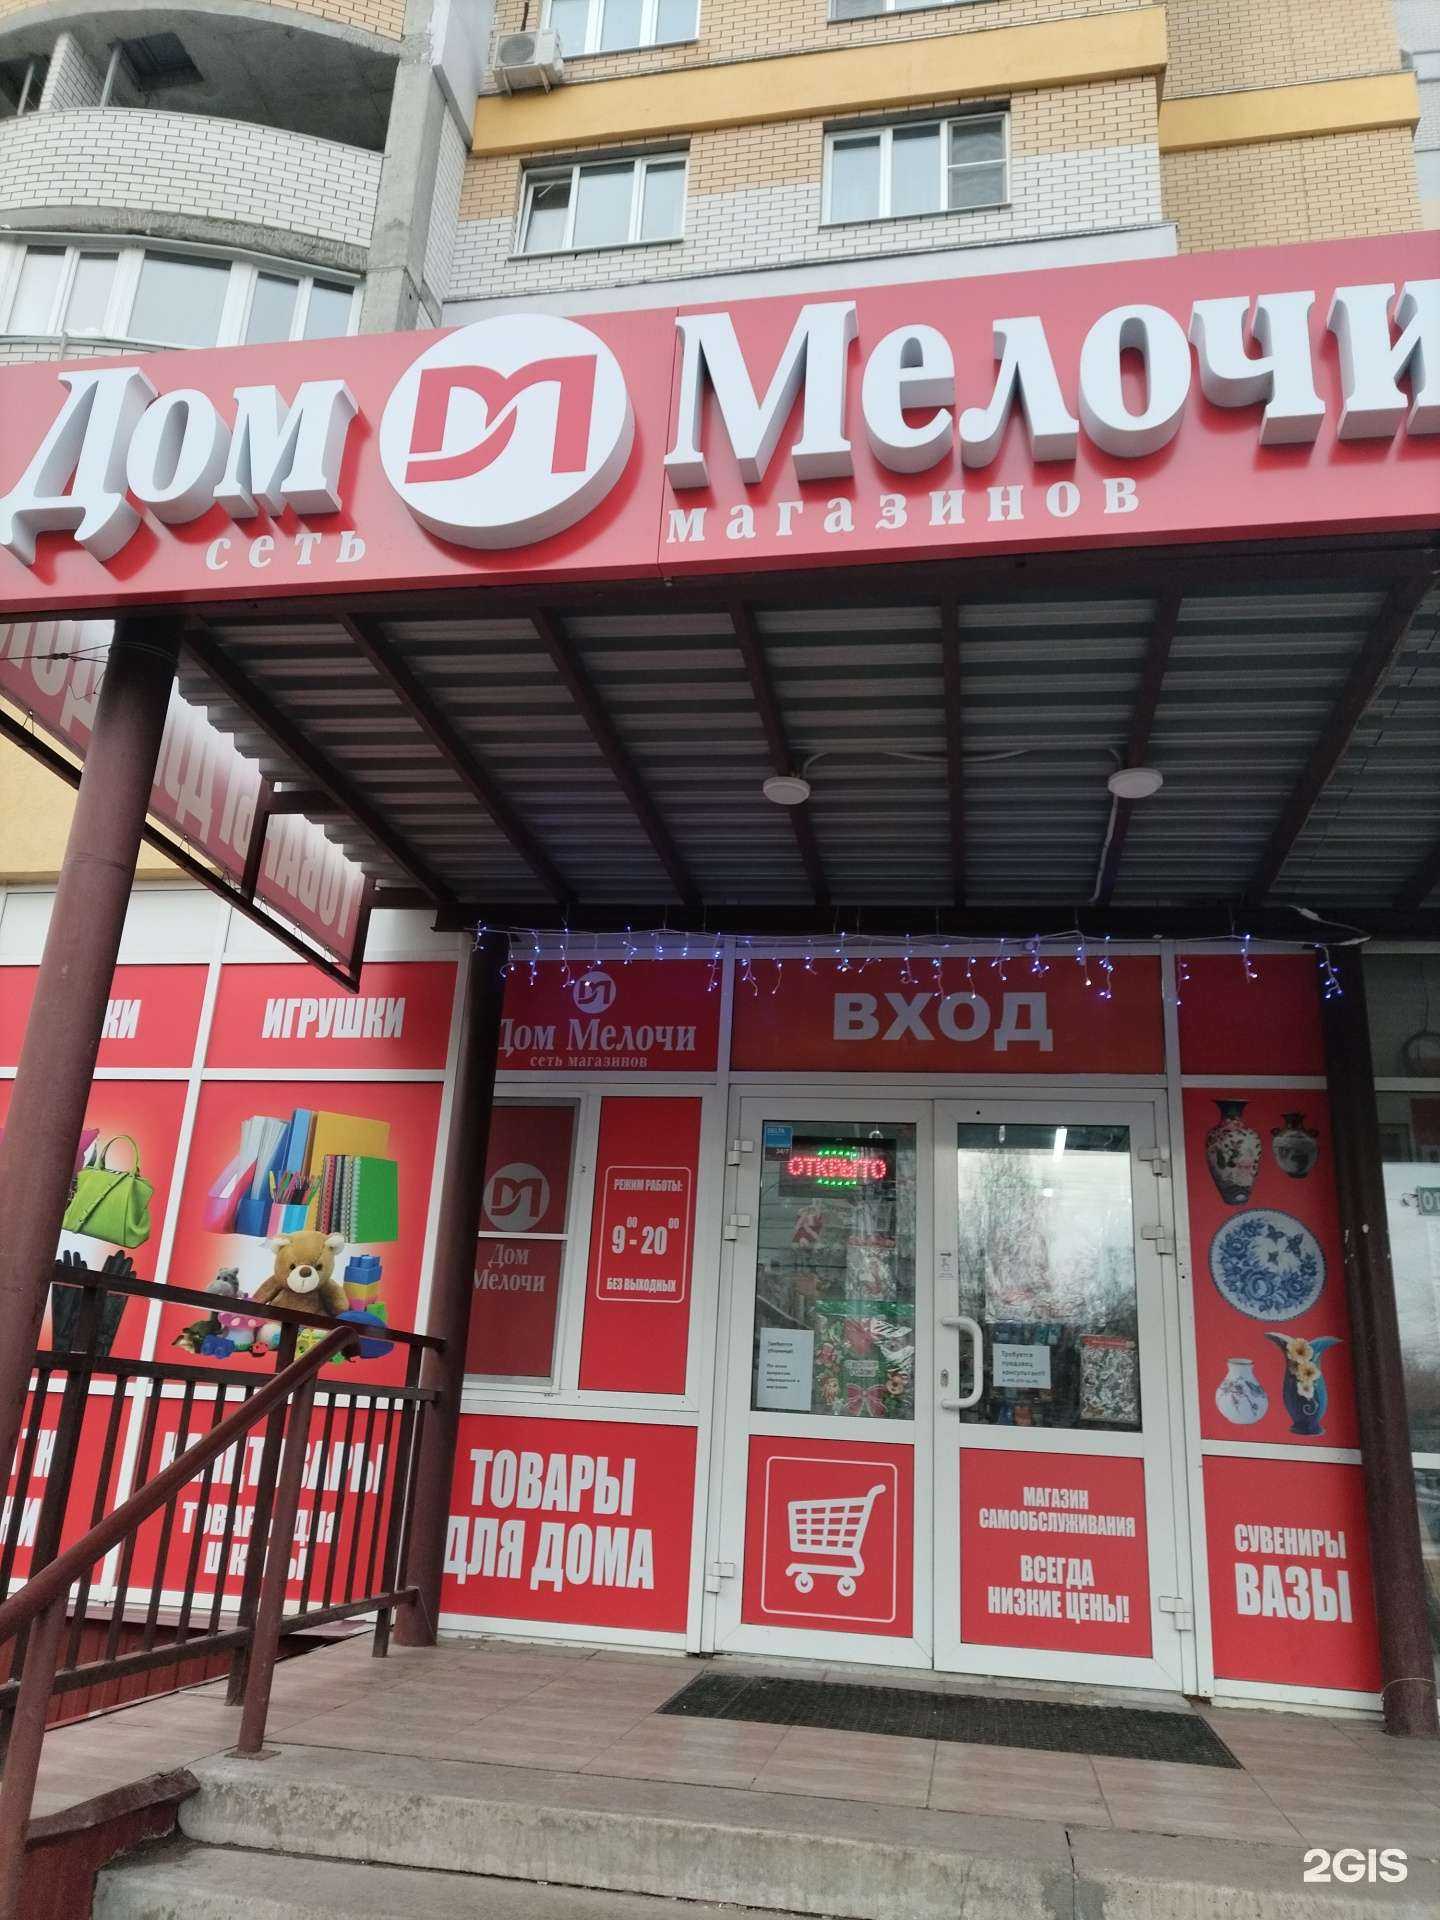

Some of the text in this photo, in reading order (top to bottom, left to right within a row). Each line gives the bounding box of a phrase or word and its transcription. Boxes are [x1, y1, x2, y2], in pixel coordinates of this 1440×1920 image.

[0, 366, 357, 562] Дом
[664, 279, 1440, 487] Мелочи
[206, 477, 1139, 570] сеть магазинов
[261, 998, 405, 1038] ИГРУШКИ
[833, 991, 1053, 1051] ВХОД
[498, 1019, 697, 1057] Дом Мелочи
[530, 1054, 648, 1068] сеть магазинов
[614, 1179, 644, 1191] РЕЖИМ
[788, 1157, 887, 1179] ОТКРЫТО
[487, 1243, 530, 1269] Дом
[473, 1268, 546, 1292] Мелочи
[607, 1277, 677, 1293] БЕЗ ВЫХОДНЫХ
[470, 1449, 636, 1516] ТОВАРЫ
[1023, 1486, 1089, 1509] МАГАЗИН
[979, 1508, 1136, 1538] САМООБСЛУЖИВАНИЯ
[1234, 1523, 1347, 1559] СУВЕНИРЫ
[443, 1515, 654, 1592] ДЛЯ ДОМА
[1020, 1555, 1095, 1587] ВСЕГДА
[988, 1586, 1131, 1624] НИЗКИЕ ЦЕНЫ!
[1235, 1562, 1353, 1624] ВАЗЫ
